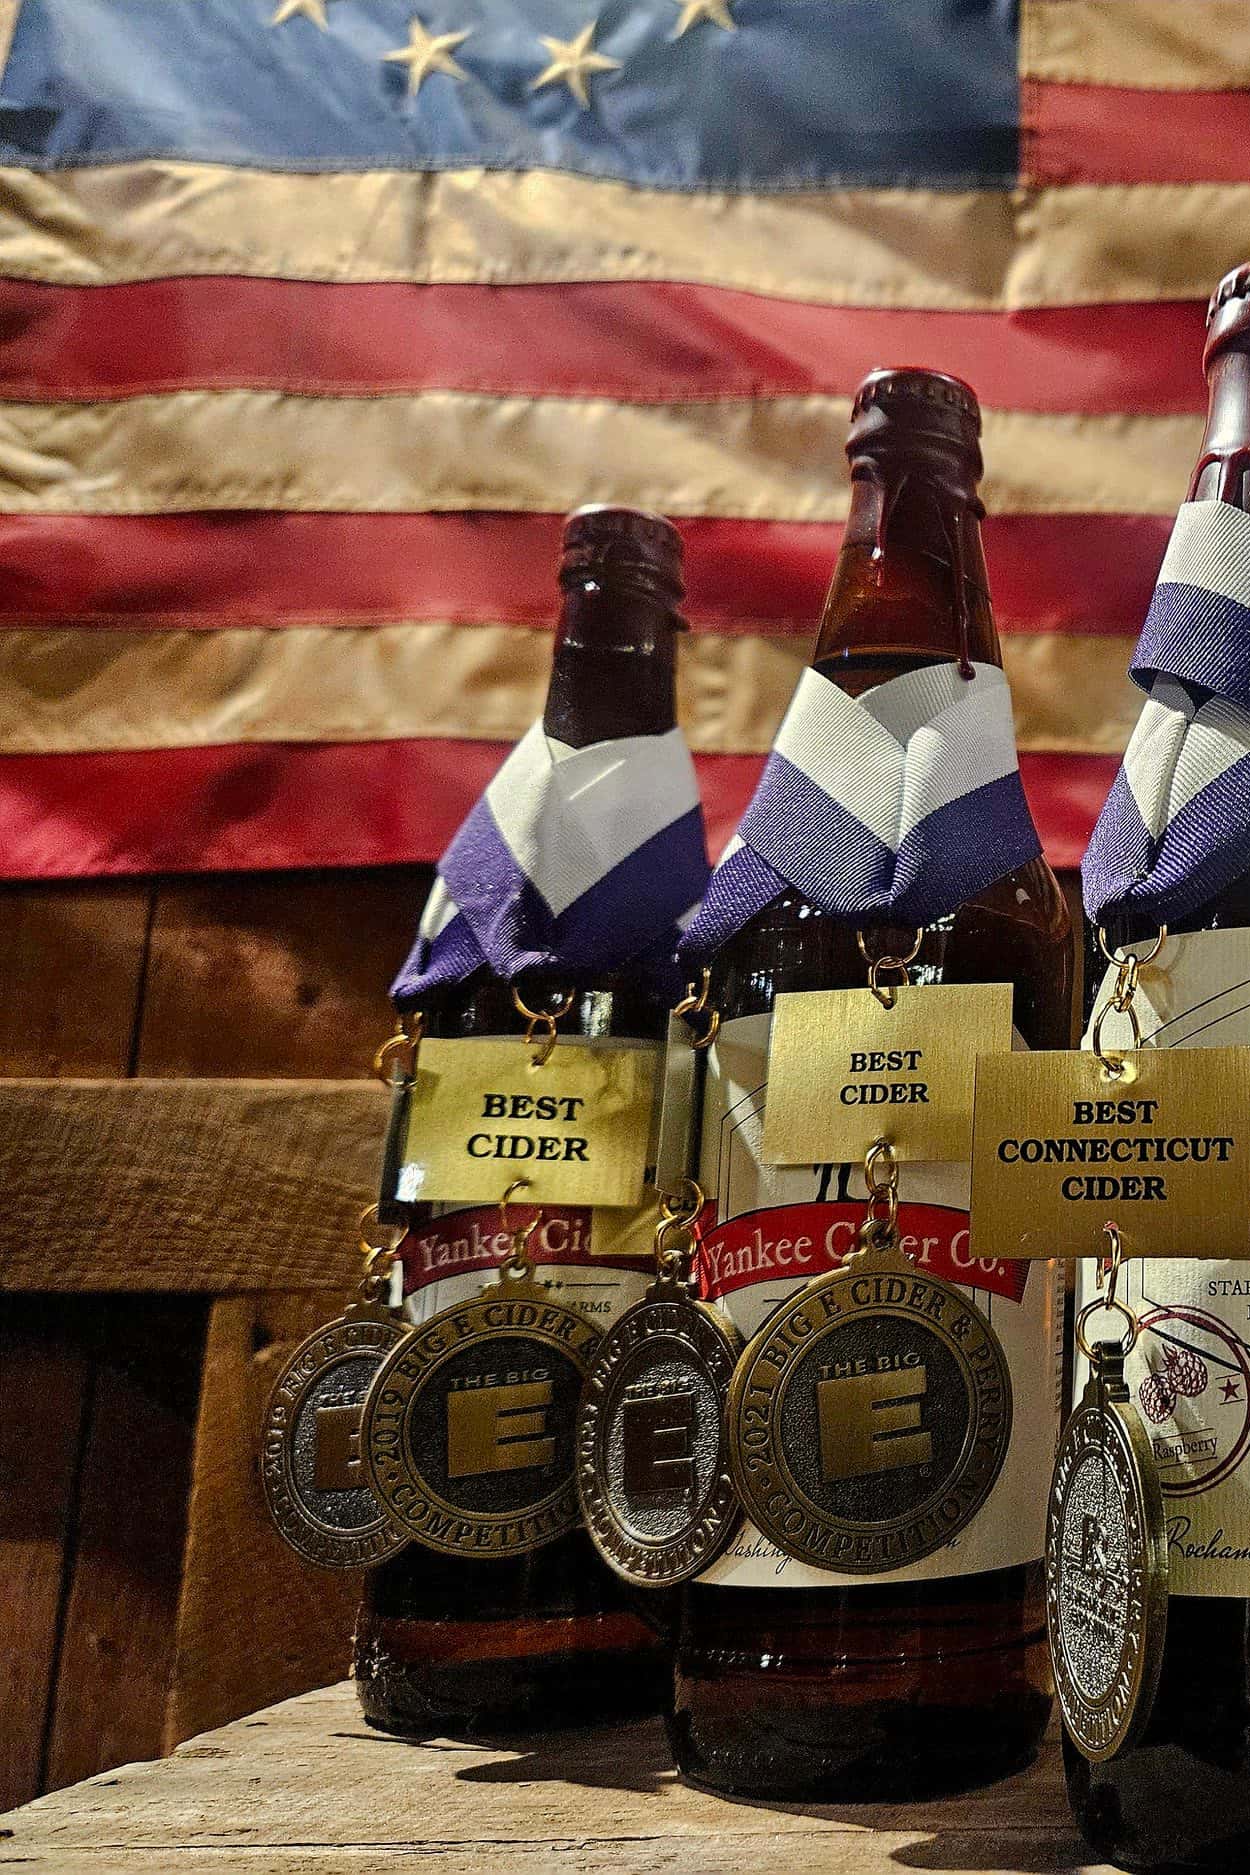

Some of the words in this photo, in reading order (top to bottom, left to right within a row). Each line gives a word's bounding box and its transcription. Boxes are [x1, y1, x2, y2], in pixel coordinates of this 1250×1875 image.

[850, 1050, 922, 1073] BEST
[481, 1092, 584, 1122] BEST
[839, 1082, 929, 1106] CIDER
[1073, 1100, 1159, 1125] BEST
[467, 1132, 590, 1162] CIDER
[998, 1137, 1235, 1163] CONNECTICUT
[1061, 1175, 1168, 1201] CIDER
[418, 1223, 514, 1272] Yanke
[708, 1228, 812, 1285] Yankee
[825, 1220, 938, 1264] Cer
[579, 1301, 612, 1313] RMS
[450, 1376, 497, 1390] THE
[505, 1368, 549, 1384] BIG
[744, 1381, 776, 1472] 2021
[761, 1311, 814, 1375] BIG
[817, 1289, 842, 1319] E
[850, 1276, 946, 1323] CIDER
[951, 1312, 975, 1342] &
[969, 1343, 1003, 1459] PERRY
[818, 1359, 868, 1380] THE
[876, 1352, 923, 1371] BIG
[374, 1389, 401, 1466] 2019
[399, 1331, 448, 1382] BIG
[452, 1314, 474, 1338] E
[484, 1303, 577, 1340] CIDER
[1153, 1436, 1217, 1461] Raspberry
[766, 1473, 985, 1563] COMPETITION
